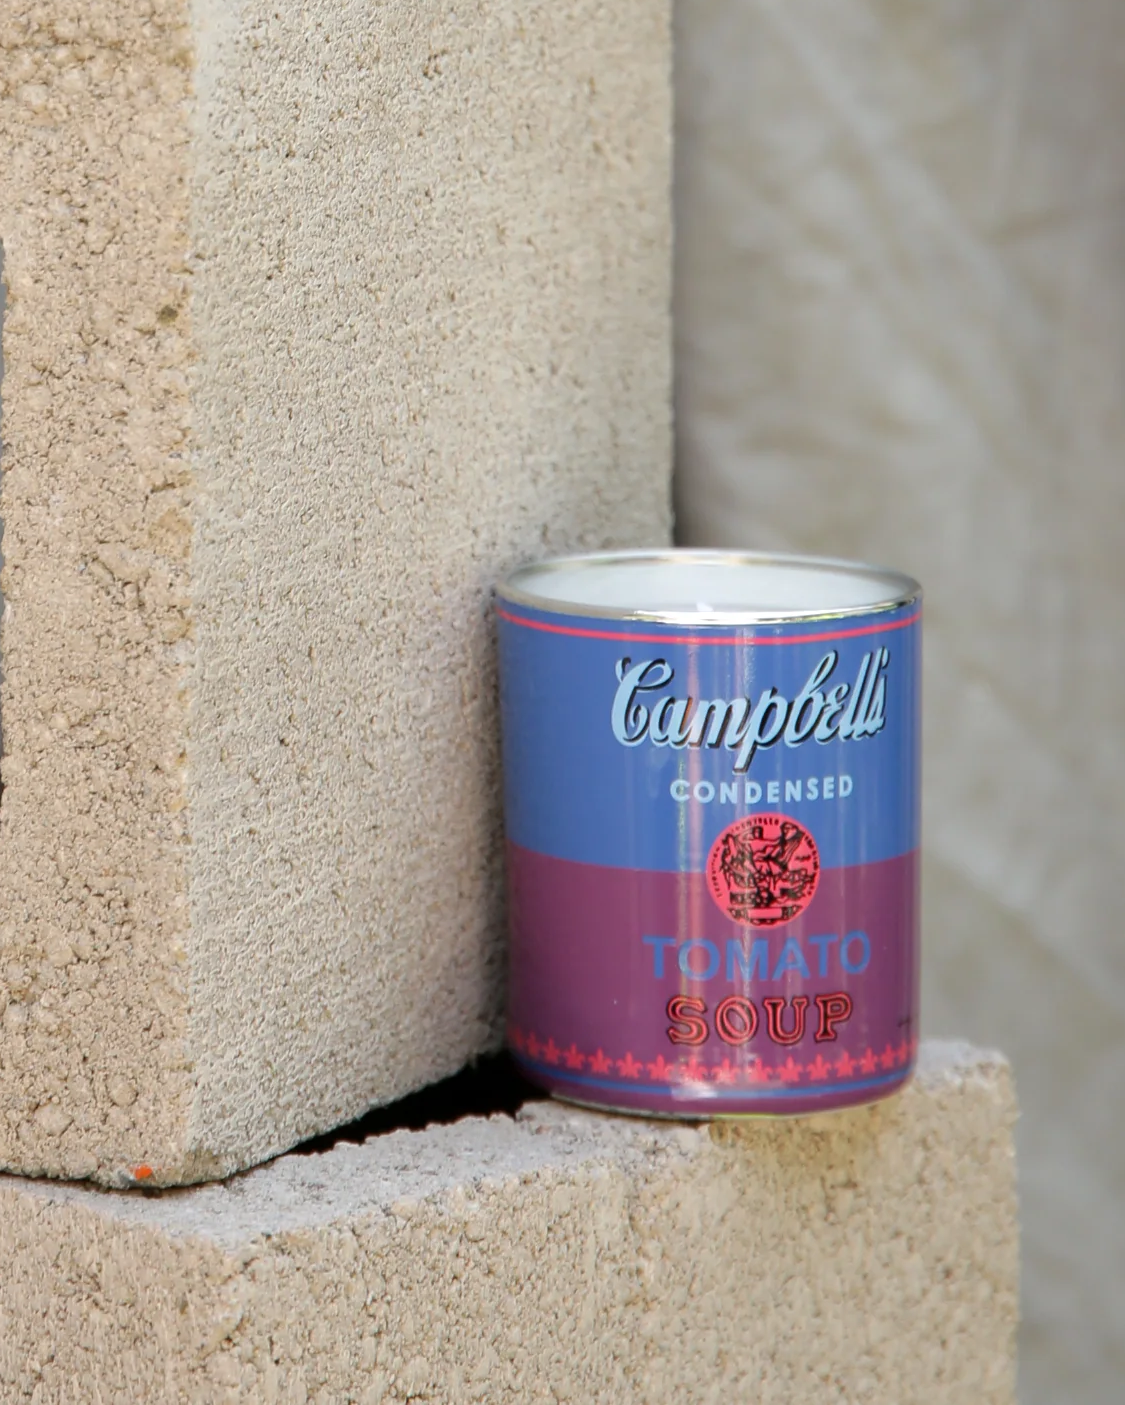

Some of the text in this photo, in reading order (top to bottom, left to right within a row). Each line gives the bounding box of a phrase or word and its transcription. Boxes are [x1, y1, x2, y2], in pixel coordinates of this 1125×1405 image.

[669, 775, 854, 804] CONDENSED
[643, 931, 871, 981] TOMATO
[666, 992, 853, 1047] SOUP
